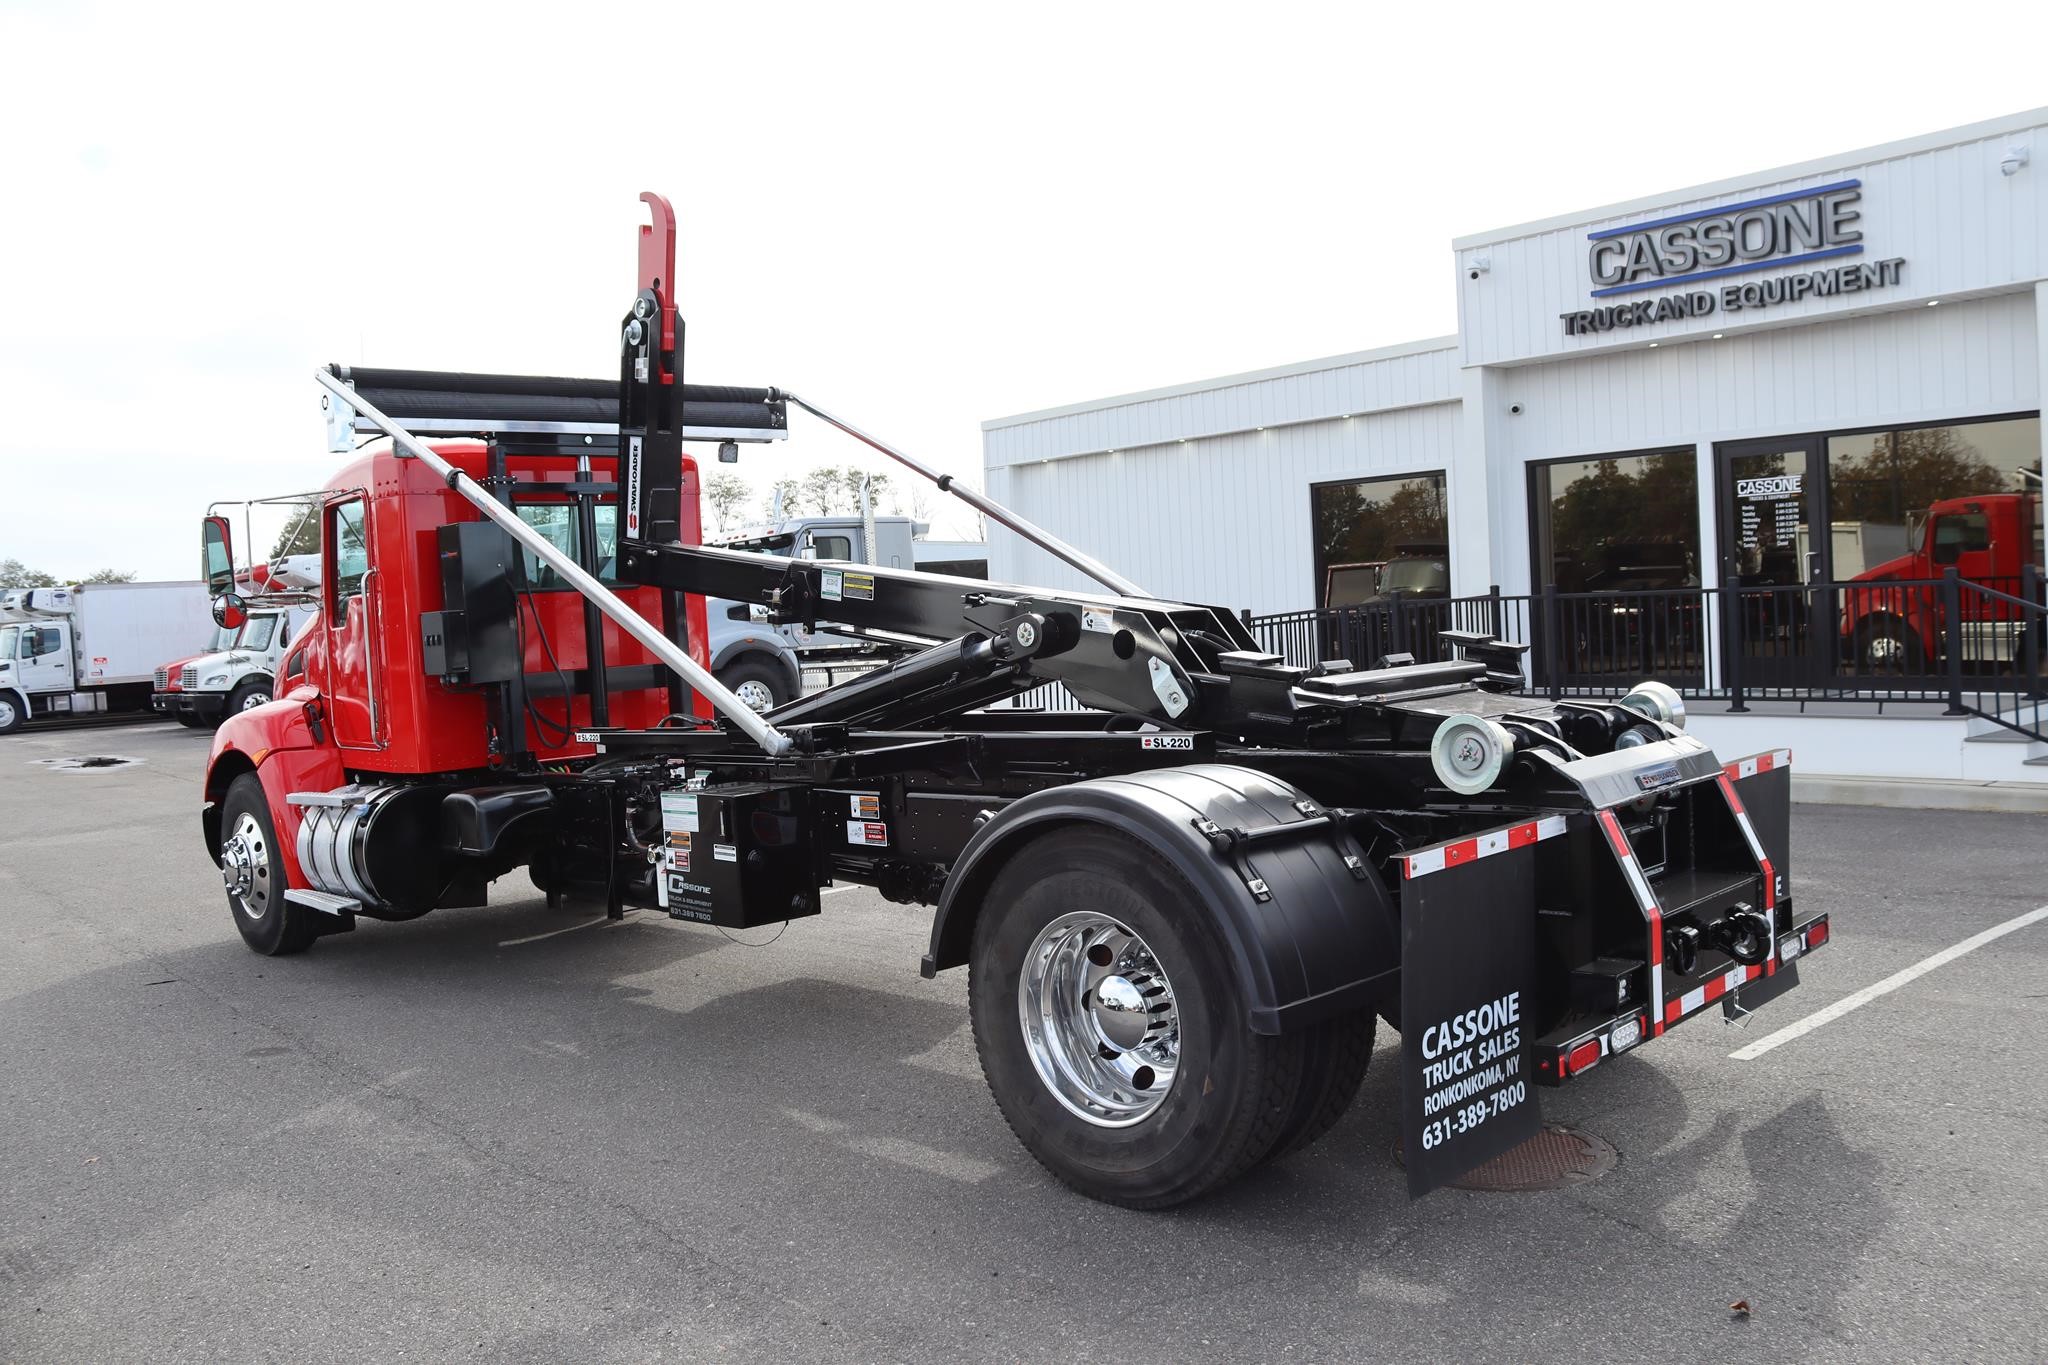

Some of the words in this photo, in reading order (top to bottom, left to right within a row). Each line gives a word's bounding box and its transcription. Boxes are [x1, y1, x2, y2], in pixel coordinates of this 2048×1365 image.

[1589, 190, 1864, 286] CASSONE
[1560, 299, 1655, 336] TRUCK
[1654, 291, 1716, 322] AND
[1720, 256, 1906, 312] EQUIPMENT
[631, 445, 639, 511] SWAPLOADER
[1737, 477, 1802, 495] CASSONE
[1153, 737, 1190, 748] SL-220
[1422, 991, 1520, 1060] CASSONE
[1423, 1048, 1473, 1089] TRUCK
[1478, 1027, 1520, 1065] SALES
[1422, 1080, 1526, 1150] 631-389-7800
[1424, 1063, 1505, 1116] RONKONKOMA,
[1506, 1054, 1520, 1077] NY
